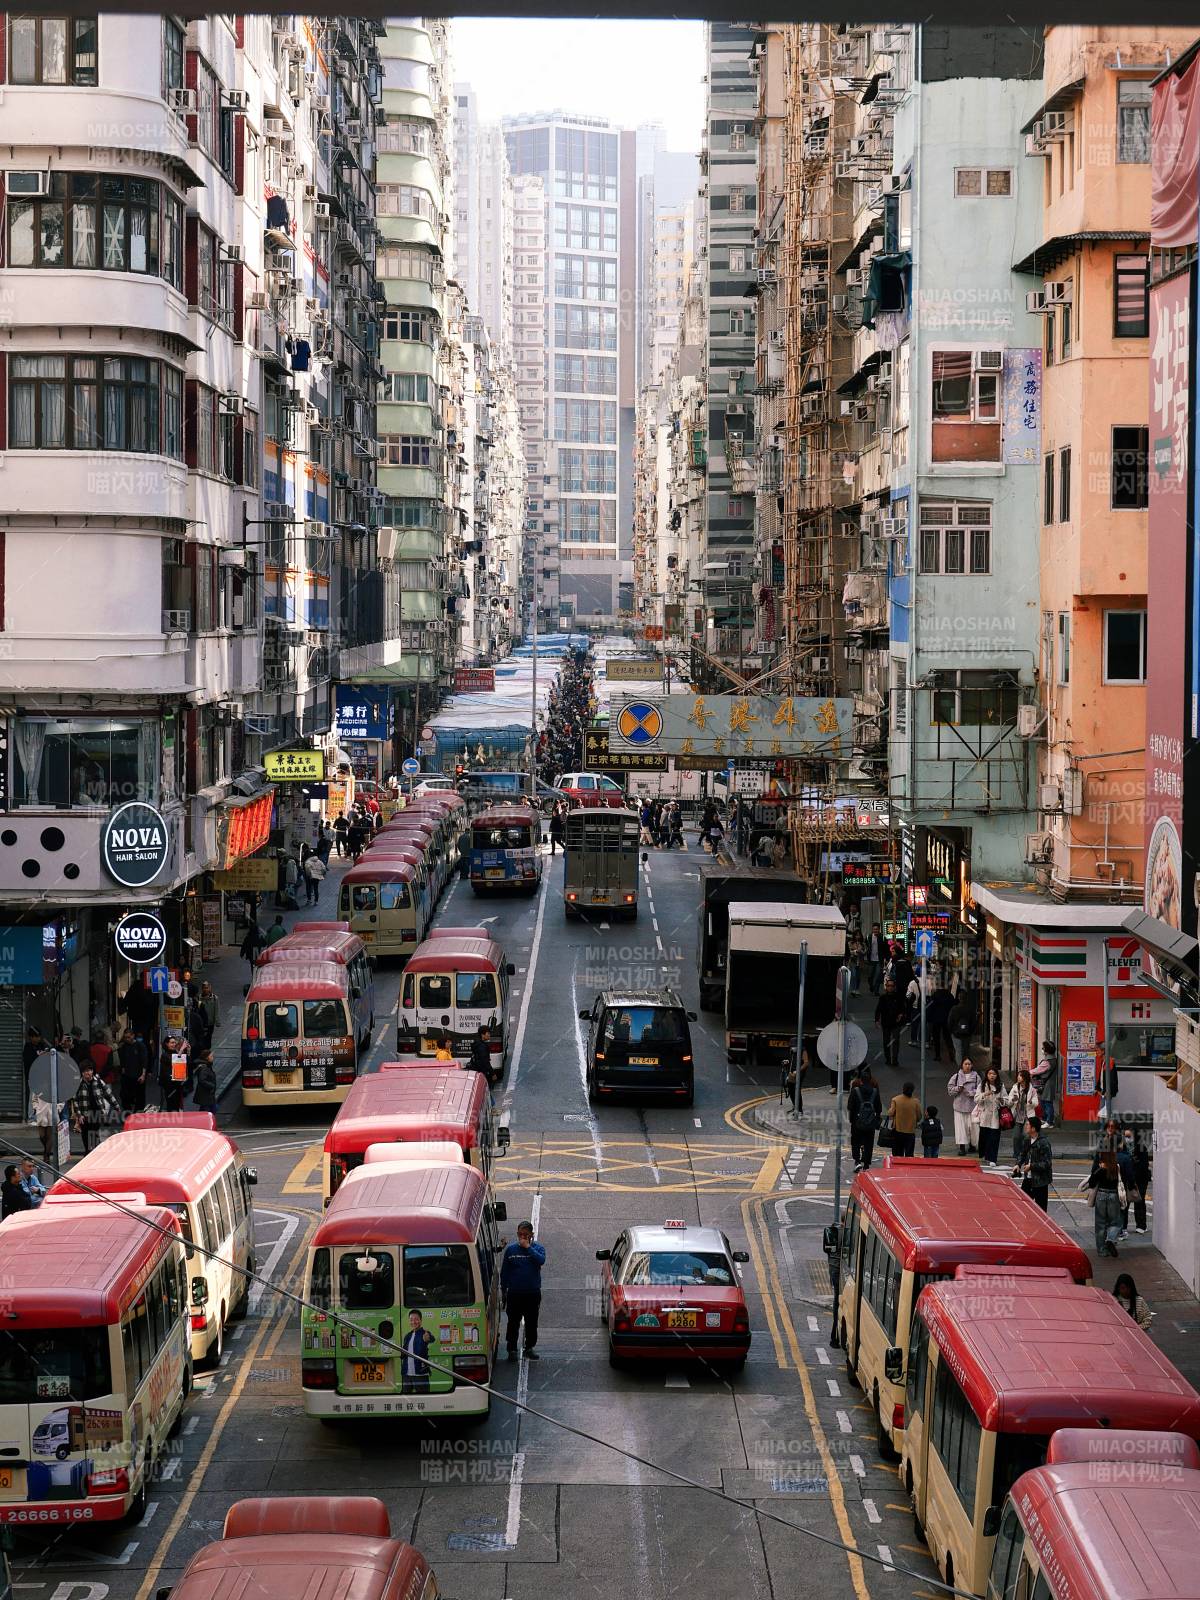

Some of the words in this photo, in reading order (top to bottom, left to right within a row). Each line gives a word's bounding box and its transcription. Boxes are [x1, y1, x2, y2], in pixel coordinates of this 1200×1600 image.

[112, 828, 162, 848] NOVA
[116, 853, 133, 861] HAIR
[135, 852, 158, 860] SALON
[120, 928, 161, 940] NOVA
[1131, 1003, 1151, 1018] Hi
[671, 1319, 694, 1327] 3280
[362, 1364, 377, 1373] MM
[356, 1373, 383, 1381] 1063
[8, 1509, 59, 1522] 26666
[64, 1507, 94, 1519] 168
